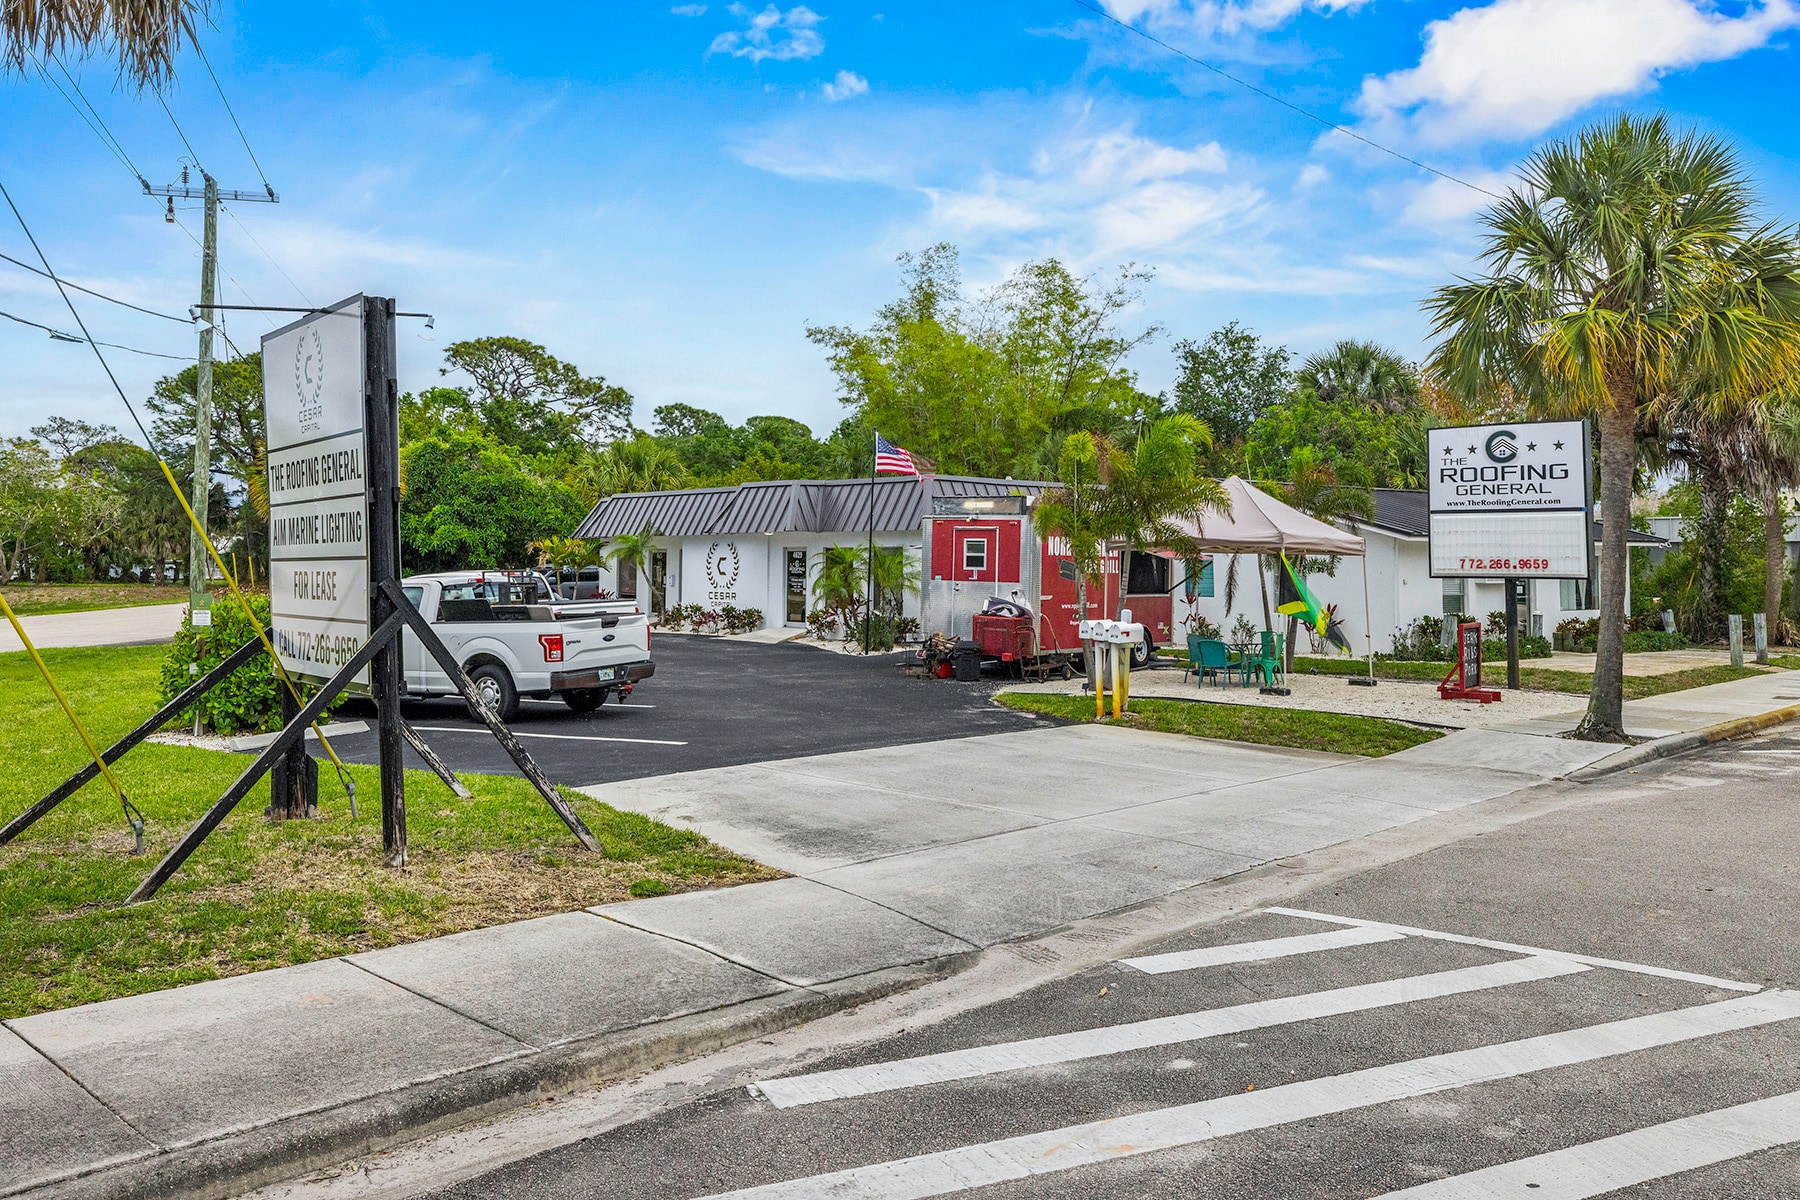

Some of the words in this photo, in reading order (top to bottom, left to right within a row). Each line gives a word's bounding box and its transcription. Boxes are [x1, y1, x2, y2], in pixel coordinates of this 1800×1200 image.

[298, 405, 323, 423] CESAR
[301, 422, 321, 434] CAPITAL
[1441, 457, 1468, 466] THE
[270, 462, 284, 492] THE
[286, 456, 319, 490] ROOFING
[321, 448, 362, 485] GENERAL
[1440, 463, 1569, 483] ROOFING
[1456, 483, 1552, 496] GENERAL
[1446, 498, 1561, 507] www.TheRoofingGeneral.com
[273, 518, 287, 546] AIM
[288, 515, 319, 545] MARINE
[321, 510, 362, 544] LIGHTING
[1100, 559, 1119, 574] GILL
[1459, 558, 1549, 570] 772.266.9659
[293, 570, 309, 599] FOR
[311, 571, 337, 601] LEASE
[708, 591, 737, 601] CESAR
[279, 629, 296, 659] CALL
